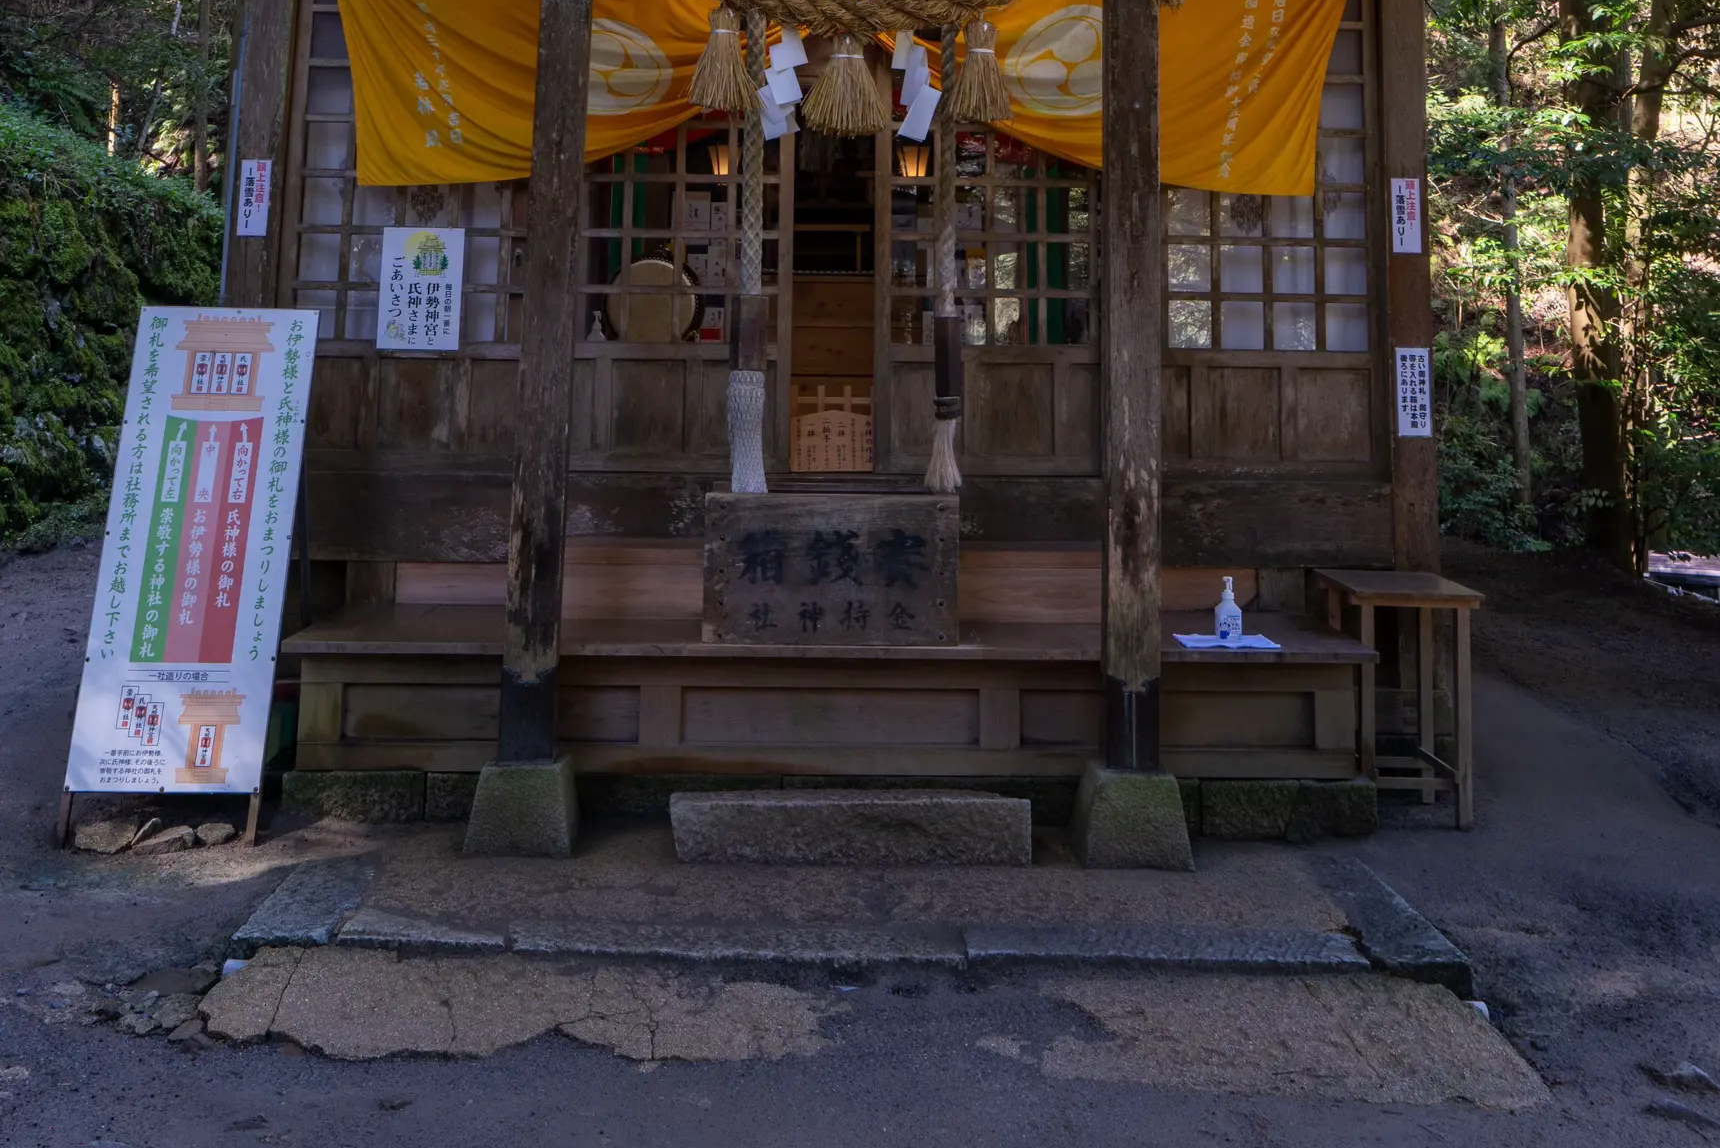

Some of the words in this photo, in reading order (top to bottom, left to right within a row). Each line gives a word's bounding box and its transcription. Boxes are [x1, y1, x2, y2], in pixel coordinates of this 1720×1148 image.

[389, 256, 405, 318] ごあいさつ
[407, 282, 422, 345] 氏神さまに
[424, 282, 441, 346] 伊勢神宮と
[442, 283, 453, 336] 毎日の朝一番に
[1399, 354, 1409, 416] 後ろにあります。
[100, 315, 168, 661] 御札を希望される方は社務所までお越し下さい
[163, 442, 184, 501] 向かって左
[198, 444, 218, 501] 中央
[229, 444, 249, 501] 向かって右
[248, 319, 304, 662] お伊勢様と氏神様の御札をおまつりしましょう
[138, 508, 178, 658] 崇敬する神社の御札
[177, 509, 207, 626] お伊勢様の御札
[214, 510, 240, 608] 氏神様の御札
[148, 671, 209, 681] 一社造りの場合
[99, 767, 162, 775] 崇敬する神社の御札を
[99, 776, 160, 784] おまつりしましょう。
